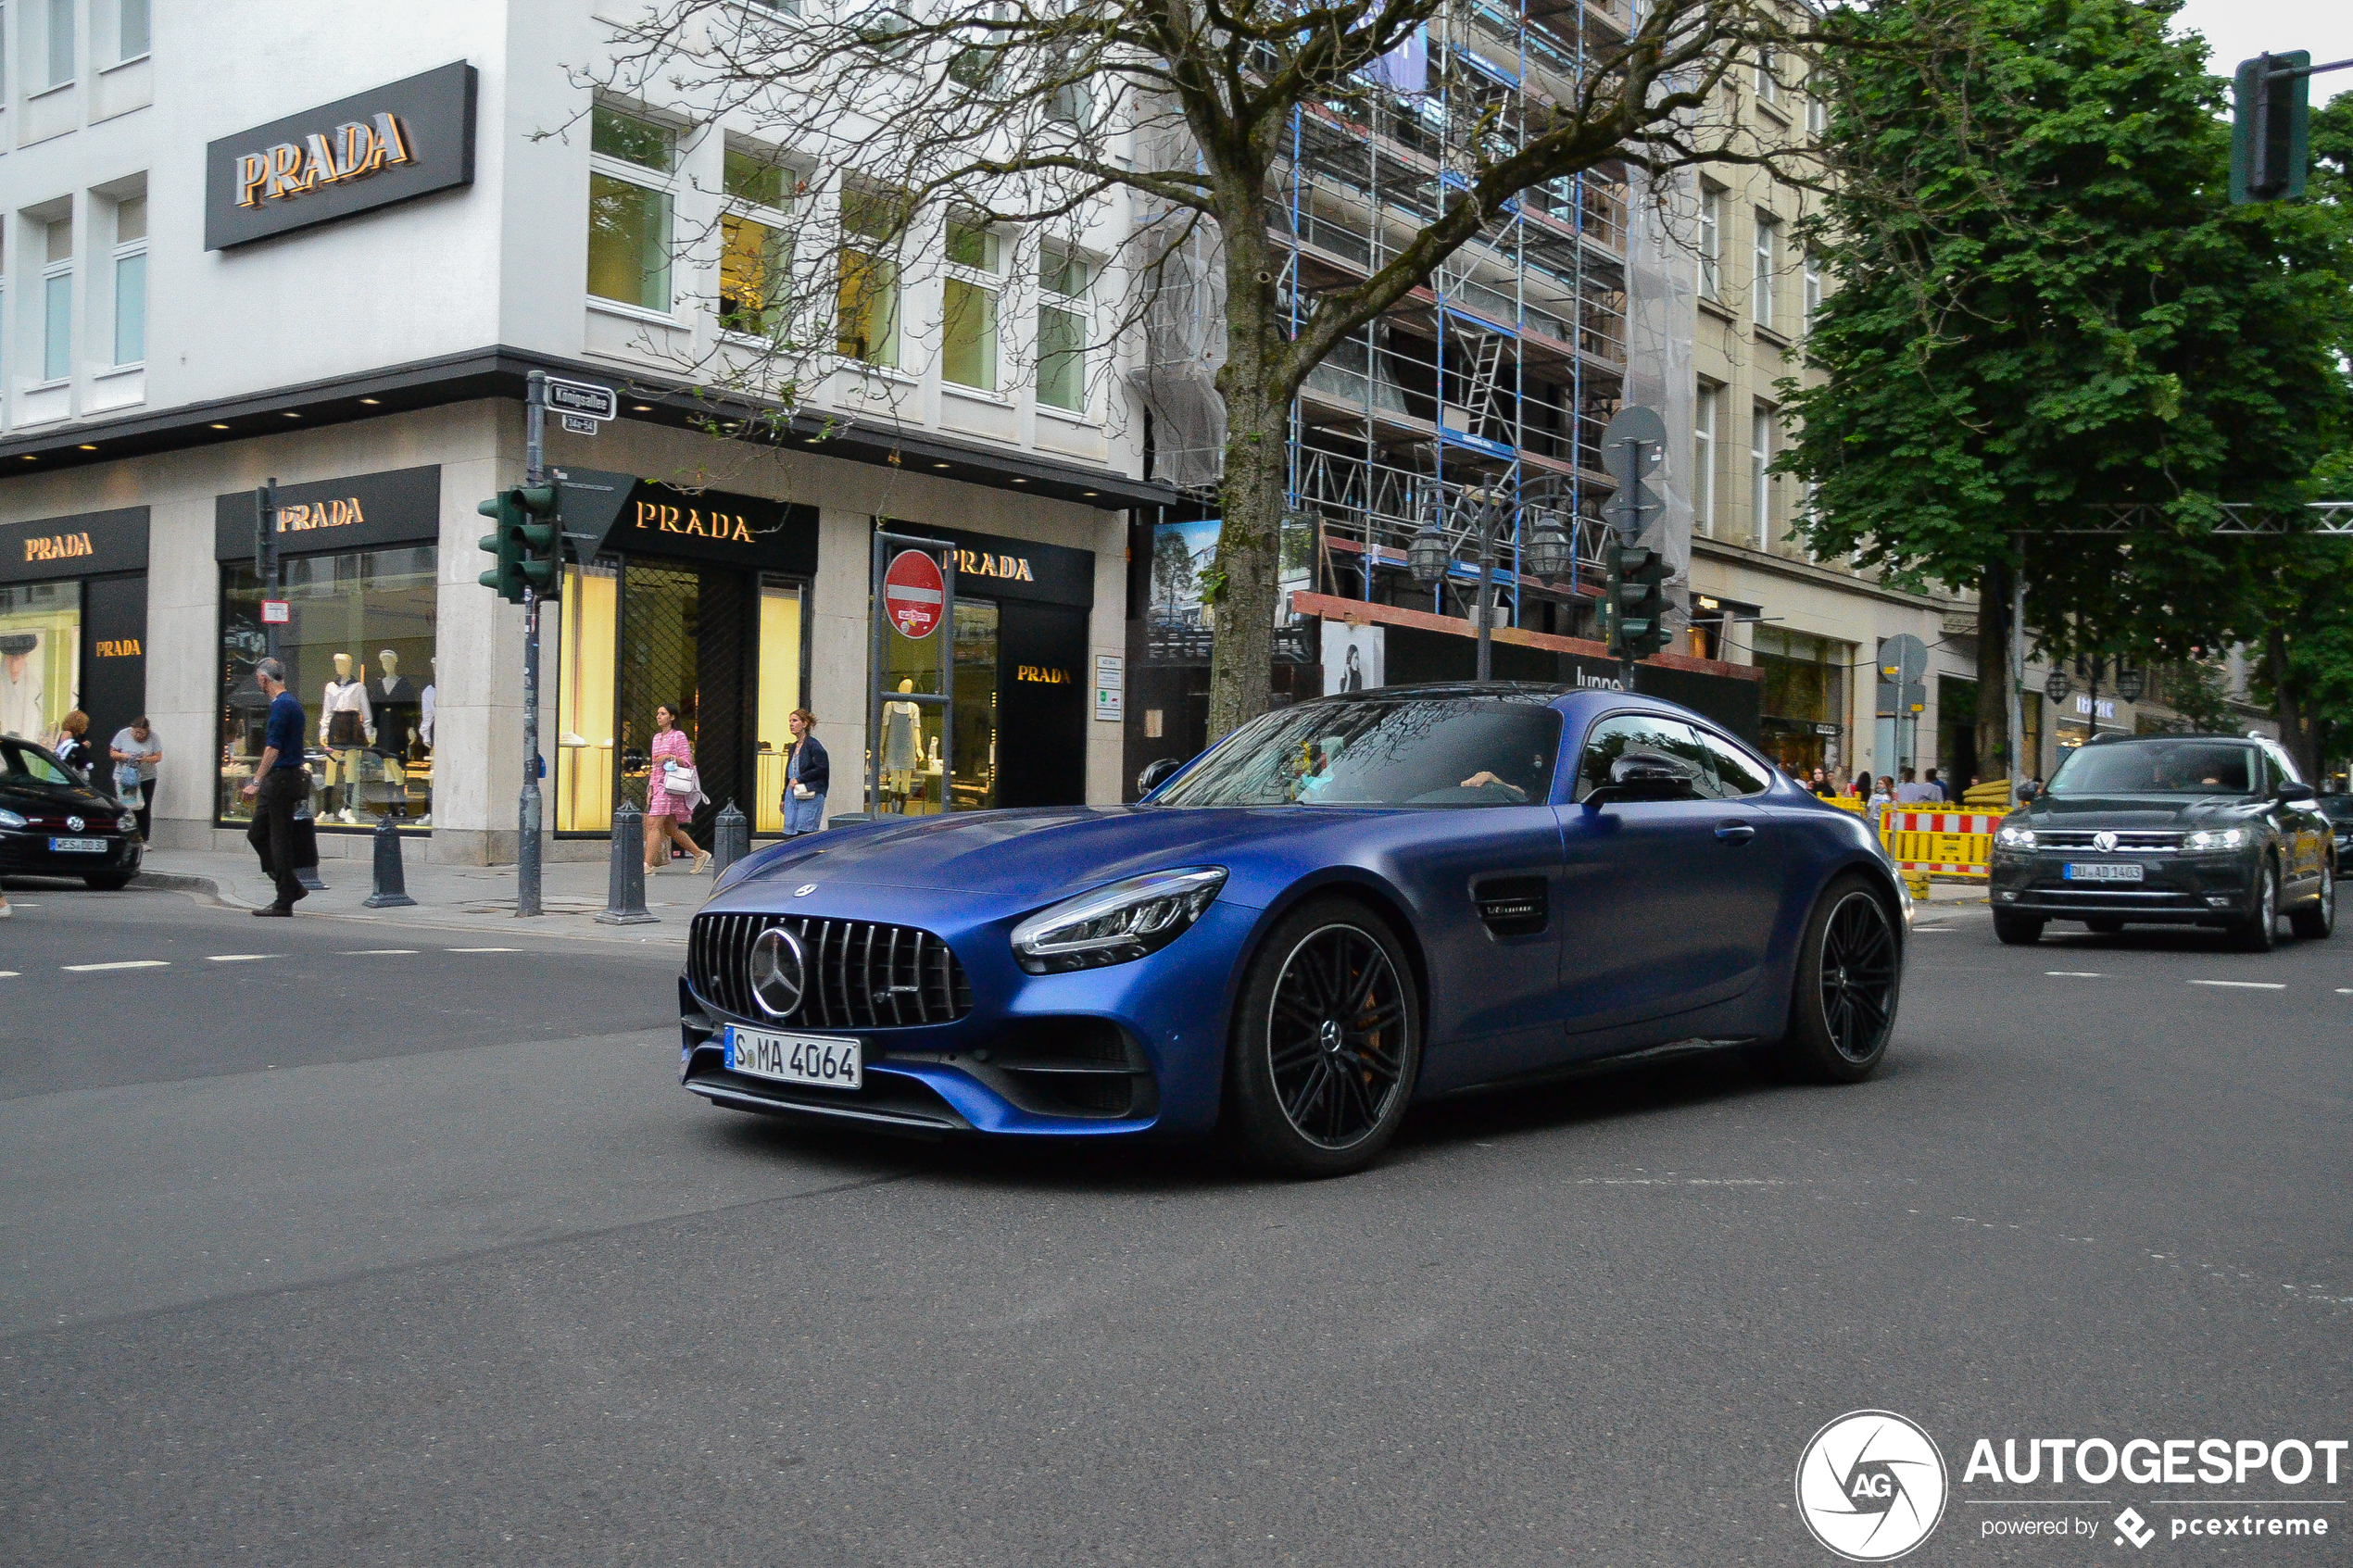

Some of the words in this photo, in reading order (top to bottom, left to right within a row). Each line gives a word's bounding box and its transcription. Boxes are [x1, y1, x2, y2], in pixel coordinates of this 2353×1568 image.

[235, 112, 408, 207] PRADA
[556, 387, 608, 410] Königsallee
[277, 497, 364, 533] PRADA
[635, 501, 756, 543] PRADA
[25, 532, 94, 562] PRADA
[96, 639, 142, 658] PRADA
[1017, 665, 1071, 684] PRADA
[2071, 866, 2085, 877] DU
[2095, 866, 2109, 878] AD
[736, 1033, 746, 1065] S
[757, 1036, 783, 1073] MA
[790, 1042, 854, 1082] 4064
